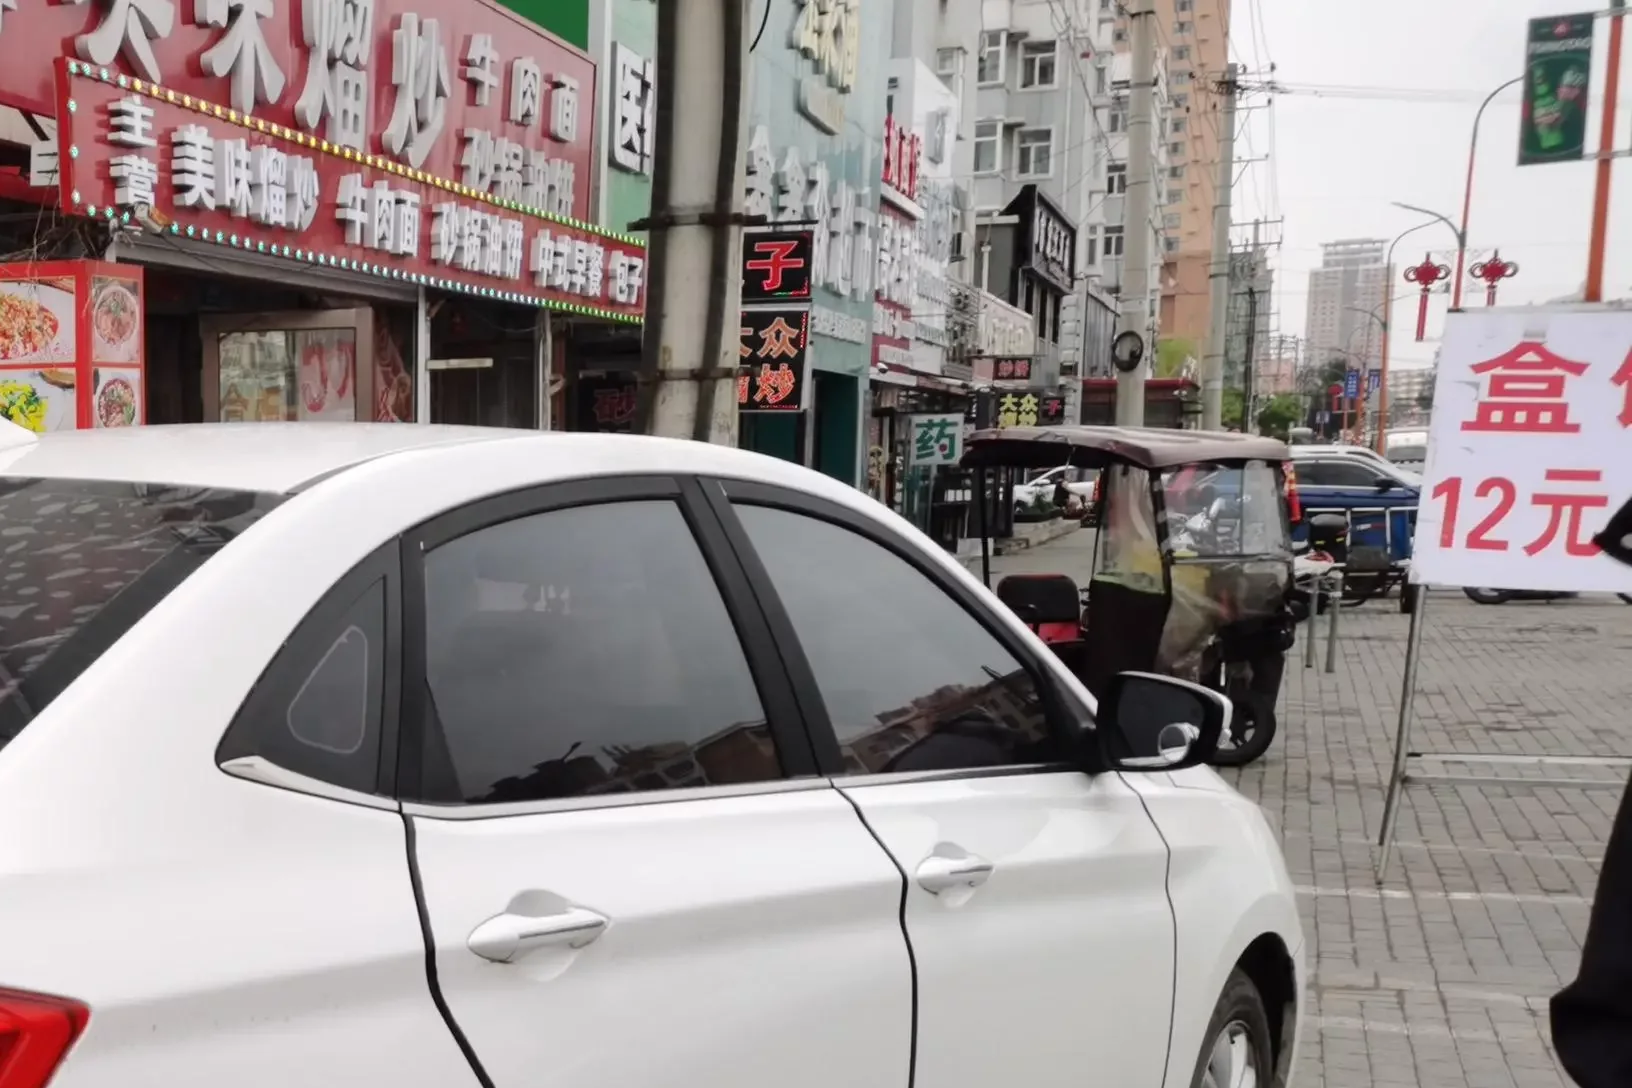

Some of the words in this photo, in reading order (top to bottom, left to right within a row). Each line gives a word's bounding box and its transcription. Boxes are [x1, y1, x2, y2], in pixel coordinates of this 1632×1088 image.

[466, 33, 579, 142] 牛肉面
[108, 95, 158, 207] 主营
[336, 172, 419, 257] 牛肉面
[430, 201, 523, 280] 砂锅油饼
[529, 228, 604, 298] 中式早餐
[608, 249, 644, 304] 包子
[746, 240, 805, 291] 子
[1460, 341, 1632, 433] 盒
[915, 418, 959, 460] 药
[1431, 468, 1609, 556] 12元
